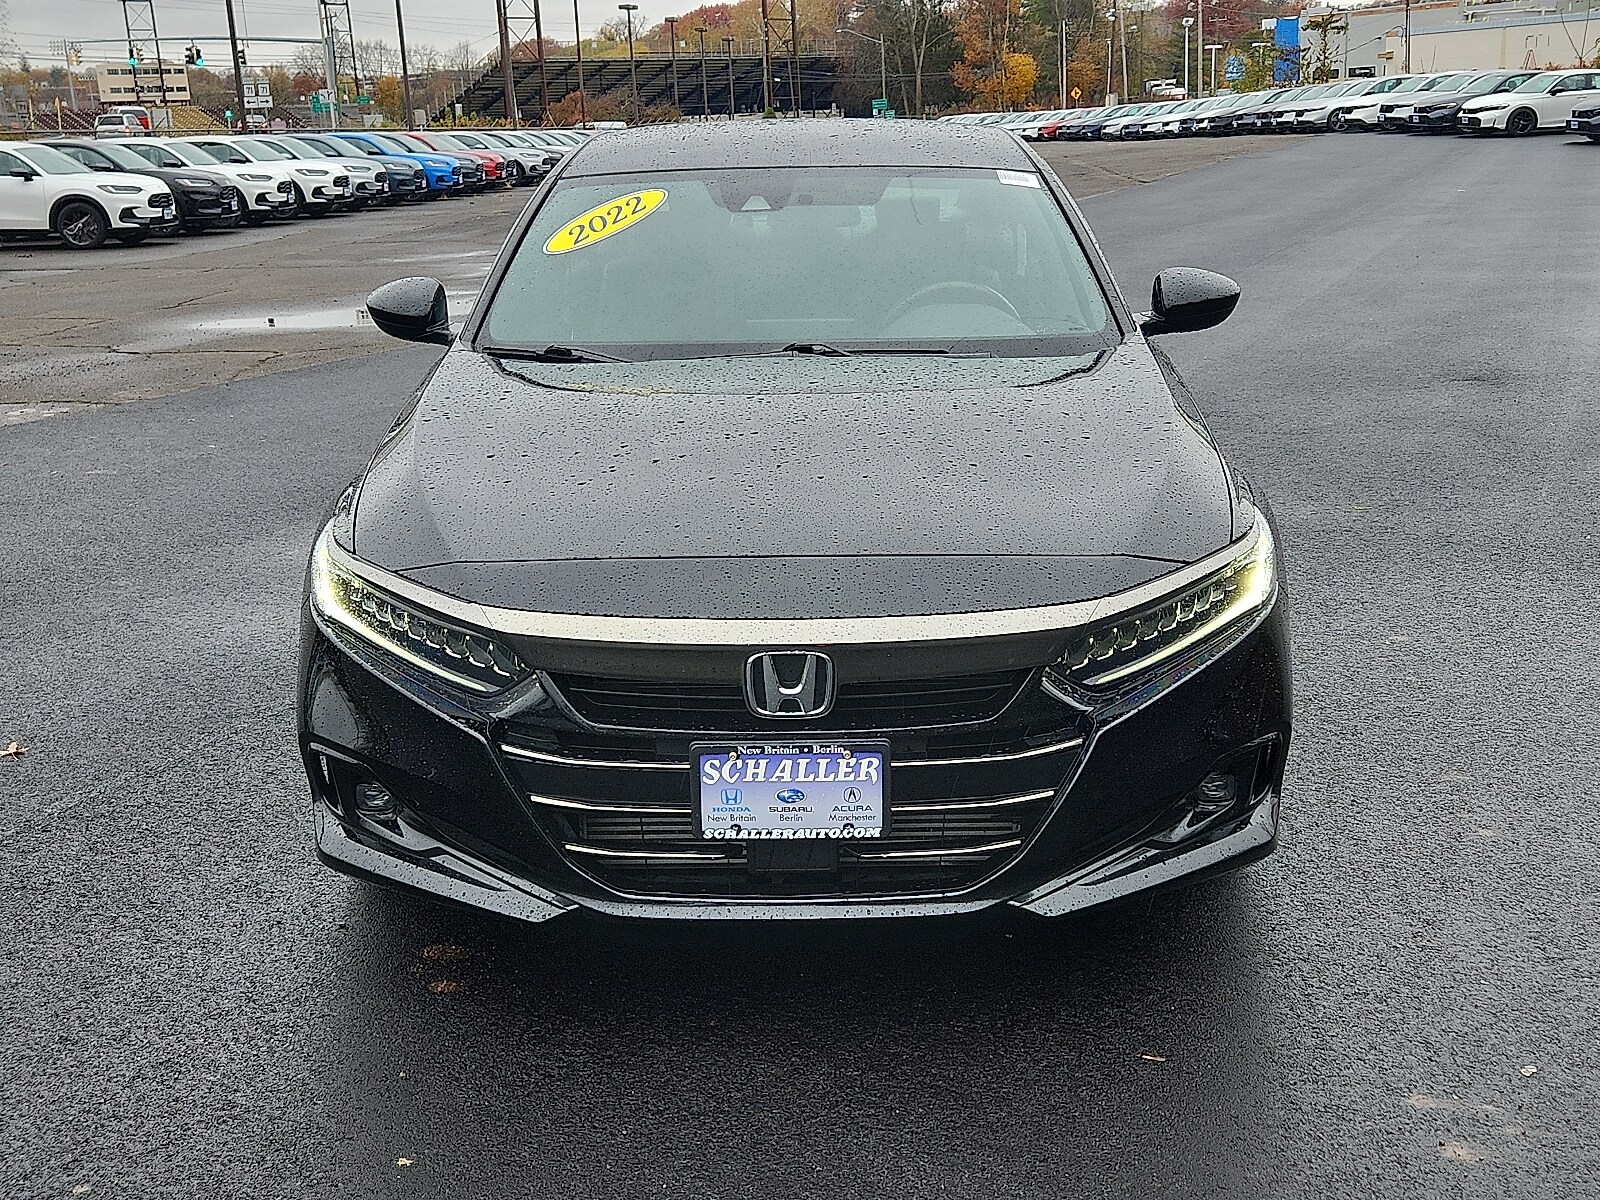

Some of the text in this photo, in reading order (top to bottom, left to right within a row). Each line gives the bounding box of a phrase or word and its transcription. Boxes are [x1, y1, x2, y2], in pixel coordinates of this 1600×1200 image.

[568, 196, 647, 245] 2022
[737, 745, 844, 754] New Britain Berlin
[702, 757, 880, 785] SCHALLER
[707, 813, 756, 822] New Britain
[779, 813, 803, 822] Berlin
[828, 813, 876, 822] Manchester
[703, 827, 881, 840] SCHALLERAUTO.COM
